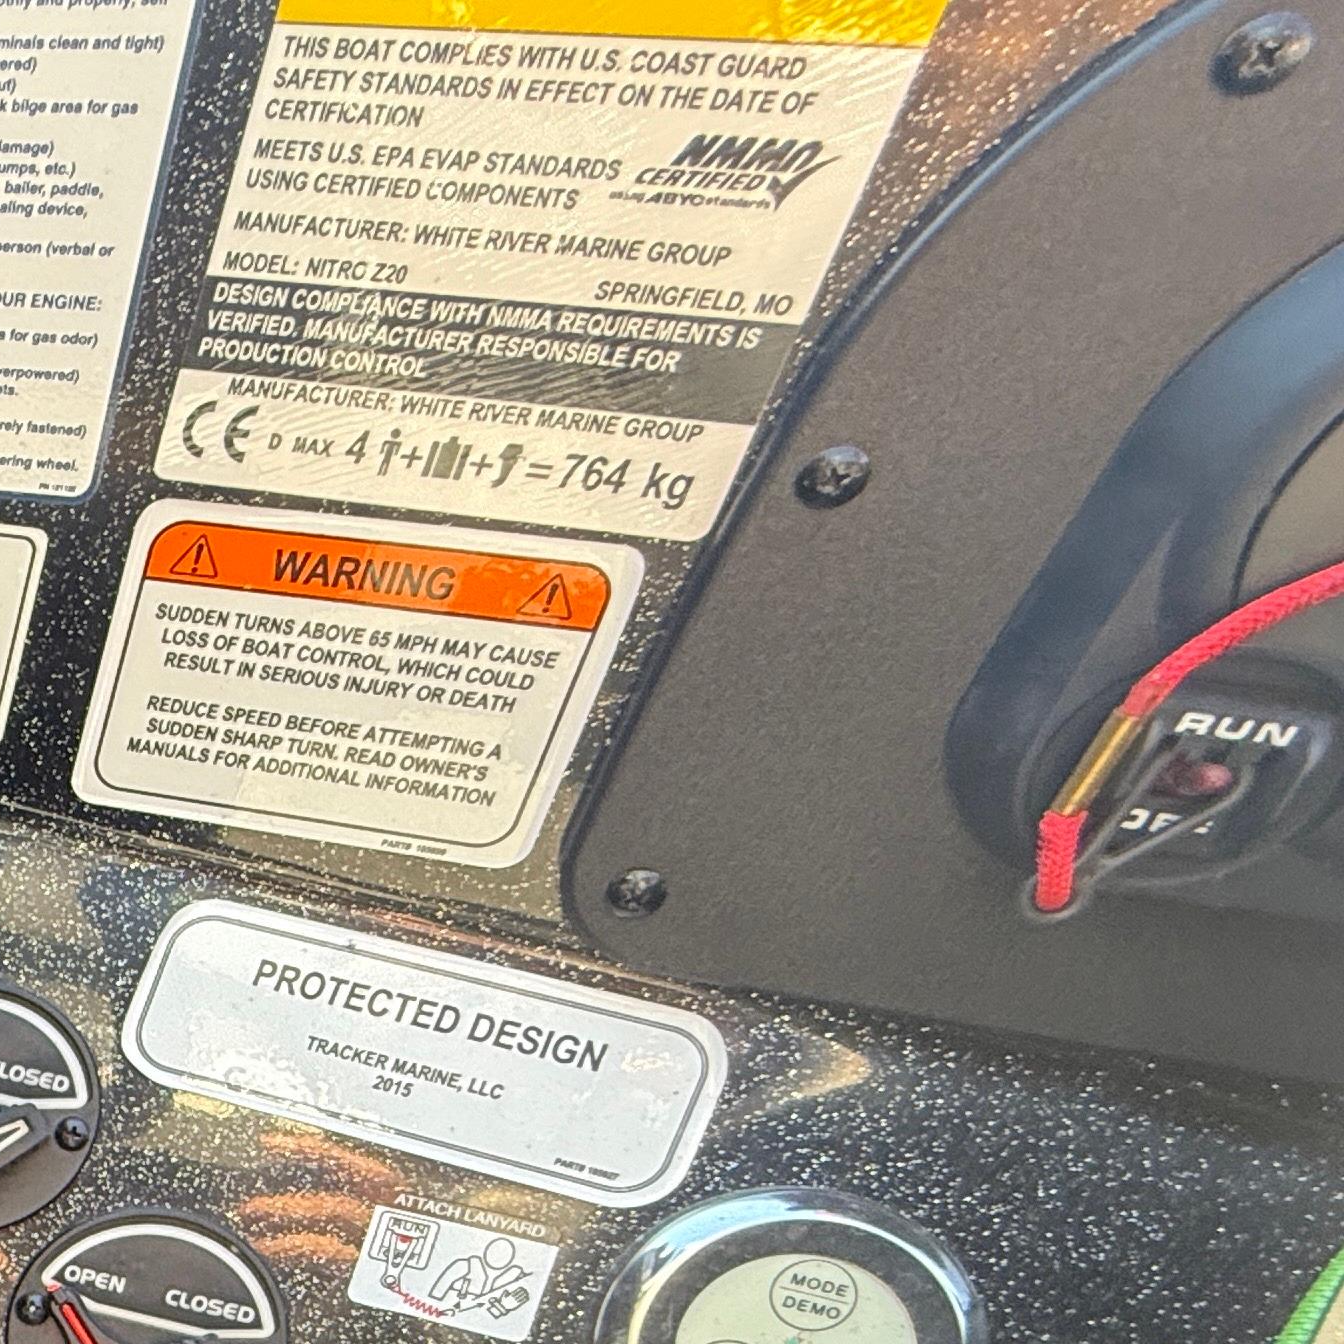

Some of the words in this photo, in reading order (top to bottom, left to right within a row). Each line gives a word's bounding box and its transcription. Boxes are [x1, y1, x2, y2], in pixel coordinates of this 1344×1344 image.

[282, 36, 331, 60] THIS
[333, 38, 395, 62] BOAT
[398, 41, 513, 67] COMPLIES
[516, 45, 577, 70] WITH
[579, 47, 624, 72] U.S.
[629, 49, 713, 75] COAST
[716, 52, 808, 79] GUARD
[273, 68, 353, 93] SAFETY
[359, 72, 494, 99] STANDARDS
[497, 78, 520, 100] IN
[524, 79, 614, 105] EFFECT
[619, 83, 654, 106] ON
[657, 85, 706, 109] THE
[708, 87, 778, 112] DATE
[780, 90, 818, 114] OF
[265, 99, 424, 127] CERTIFICATION
[254, 139, 323, 163] MEETS
[327, 143, 368, 165] U.S.
[373, 146, 417, 168] EPA
[420, 148, 480, 172] EVAP
[483, 152, 623, 180] STANDARDS
[635, 167, 767, 191] CERTIFIED
[246, 169, 308, 192] USING
[312, 173, 421, 199] CERTIFIED
[426, 180, 580, 209] COMPONENTS
[234, 211, 409, 243] MANUFACTURER:
[413, 224, 482, 248] WHITE
[484, 228, 552, 253] RIVER
[555, 233, 643, 260] MARINE
[646, 239, 733, 266] GROUP
[224, 251, 298, 274] MODEL:
[306, 257, 368, 280] NITRO
[371, 262, 408, 283] Z20
[30, 293, 101, 311] ENGINE:
[214, 283, 288, 308] DESIGN
[292, 289, 426, 320] COMPLIANCE
[429, 300, 484, 325] WITH
[486, 305, 555, 330] NMMA
[557, 311, 735, 346] REQUIREMENTS
[737, 325, 763, 348] IS
[594, 281, 751, 312] SPRINGFIELD,
[754, 293, 795, 316] MO
[199, 338, 326, 367] PRODUCTION
[330, 350, 429, 376] CONTROL
[206, 311, 300, 338] VERIFIED.
[303, 319, 473, 353] MANUFACTURER
[476, 334, 630, 367] RESPONSIBLE
[631, 347, 682, 371] FOR
[228, 378, 395, 412] MANUFACTURER:
[399, 395, 464, 419] WHITE
[468, 402, 532, 426] RIVER
[536, 408, 619, 434] MARINE
[622, 417, 704, 443] GROUP
[36, 457, 78, 471] wheel.
[268, 432, 281, 450] D
[293, 435, 333, 455] MAX
[344, 434, 369, 463] 4
[638, 463, 699, 510] kg
[274, 549, 455, 599] WARNING
[155, 602, 230, 627] SUDDEN
[235, 612, 295, 635] TURNS
[297, 621, 366, 644] ABOVE
[368, 630, 392, 647] 65
[393, 633, 438, 653] MPH
[440, 638, 487, 659] MAY
[489, 644, 560, 668] CAUSE
[161, 627, 209, 648] LOSS
[213, 634, 239, 651] OF
[241, 638, 294, 659] BOAT
[296, 645, 390, 675] CONTROL,
[397, 657, 462, 681] WHICH
[465, 666, 534, 690] COULD
[163, 652, 235, 675] RESULT
[236, 661, 256, 678] IN
[258, 664, 340, 689] SERIOUS
[343, 675, 415, 698] INJURY
[416, 685, 445, 703] OR
[448, 689, 516, 713] DEATH
[146, 695, 219, 719] REDUCE
[222, 706, 281, 727] SPEED
[284, 715, 361, 739] BEFORE
[362, 726, 484, 757] ATTEMPTING
[485, 744, 500, 760] A
[1174, 712, 1299, 747] RUN
[146, 718, 218, 741] SUDDEN
[221, 728, 283, 750] SHARP
[287, 737, 337, 760] TURN.
[343, 746, 395, 767] READ
[399, 755, 488, 781] OWNER'S
[126, 737, 209, 763] MANUALS
[212, 750, 250, 769] FOR
[252, 756, 359, 786] ADDITIONAL
[364, 773, 496, 806] INFORMATION
[1120, 808, 1214, 834] OF
[252, 959, 460, 1033] PROTECTED
[466, 1012, 608, 1071] DESIGN
[307, 1035, 388, 1070] TRACKER
[390, 1058, 462, 1092] MARINE,
[467, 1077, 504, 1099] LLC
[371, 1075, 413, 1097] 2015
[394, 1194, 462, 1219] ATTACH
[465, 1208, 546, 1238] LANYARD
[63, 1264, 127, 1294] OPEN
[790, 1272, 849, 1299] MODE
[165, 1288, 256, 1325] CLOSED
[782, 1295, 841, 1320] DEMO
